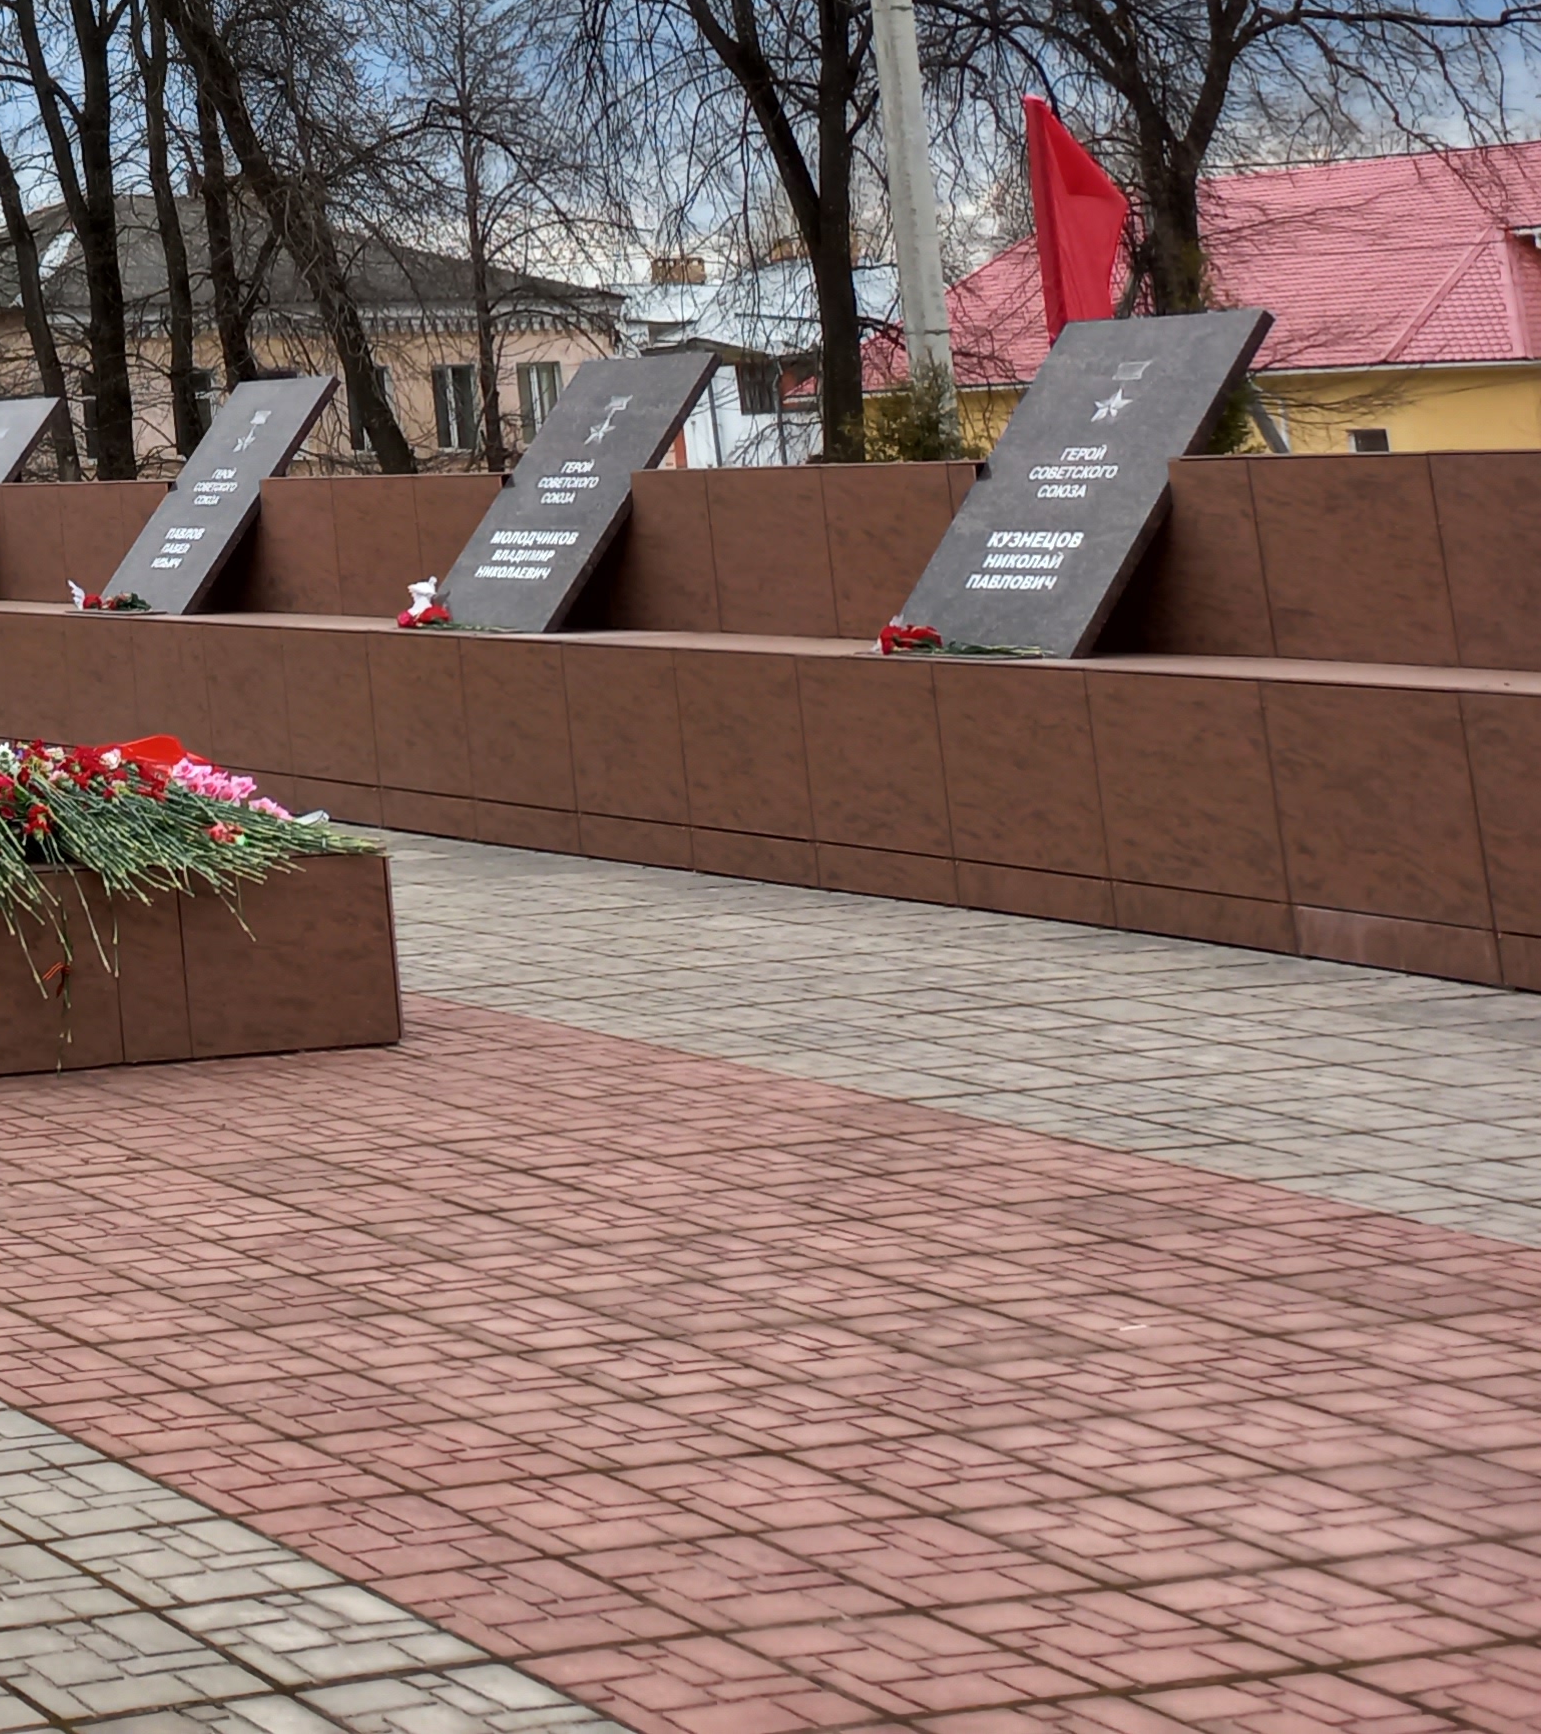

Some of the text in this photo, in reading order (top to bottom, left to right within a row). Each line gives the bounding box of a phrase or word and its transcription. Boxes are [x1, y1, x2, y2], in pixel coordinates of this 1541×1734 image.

[1060, 444, 1107, 461] ГЕРОЙ
[561, 459, 595, 473] ГЕРОЙ
[1028, 465, 1118, 480] СОВЕТСКОГО
[538, 477, 599, 488] СОВЕТСКОГО
[541, 491, 575, 504] СОЮЗА
[1037, 484, 1087, 498] СОЮЗА
[490, 531, 578, 546] МОЛОДЧИКОВ
[986, 531, 1084, 550] КУЗНЕЦОВ
[491, 549, 555, 563] ВЛАДИМИР
[982, 551, 1064, 569] НИКОЛАЙ
[474, 565, 551, 579] НИКОЛАЕВИЧ
[965, 574, 1058, 590] ПАВЛОВИЧ
